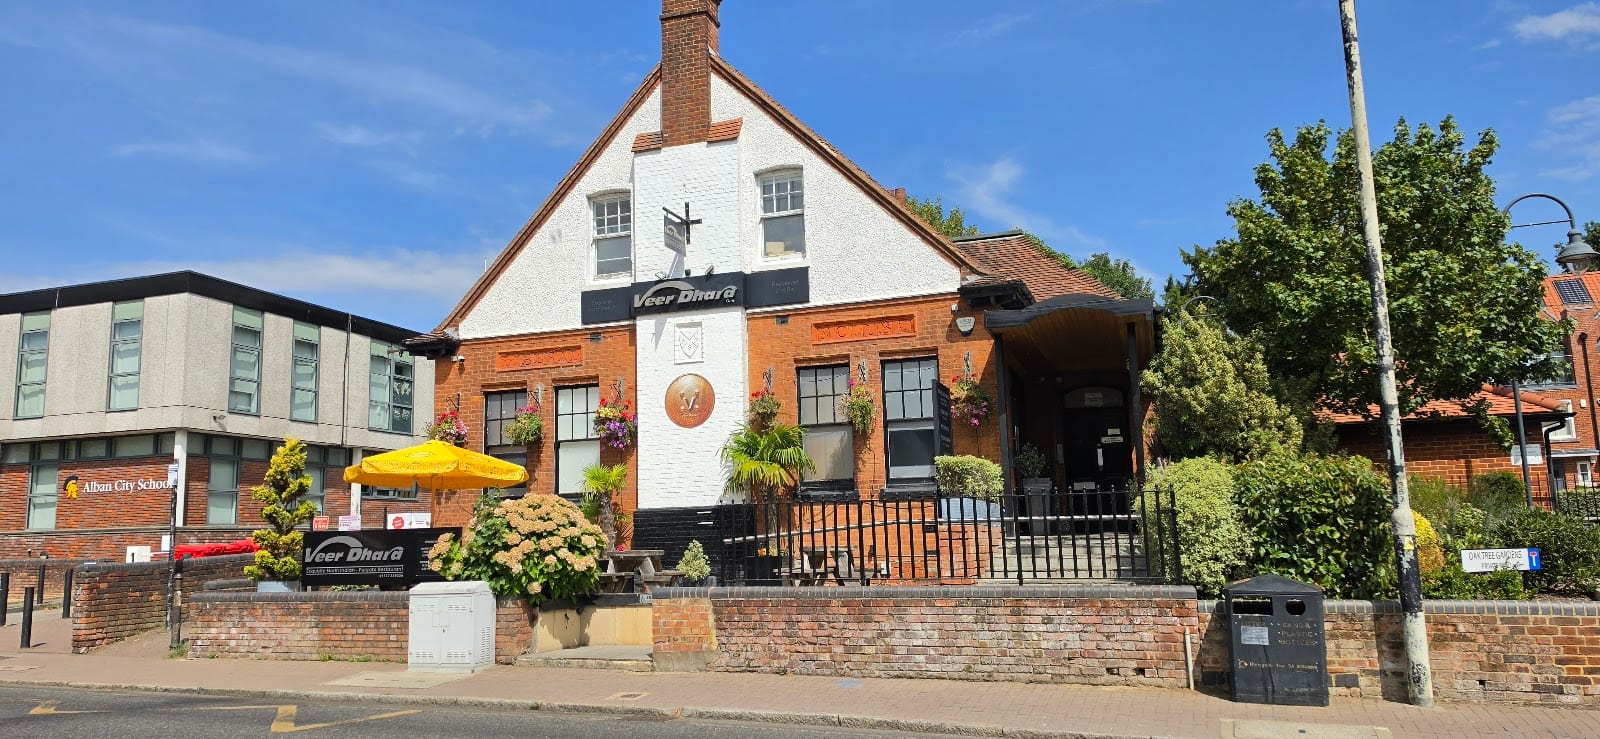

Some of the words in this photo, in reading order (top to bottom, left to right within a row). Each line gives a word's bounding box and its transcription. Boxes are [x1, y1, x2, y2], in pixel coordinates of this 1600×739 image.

[633, 293, 675, 308] Veer
[83, 481, 112, 493] Alban
[114, 479, 136, 493] City
[305, 547, 344, 563] Veer
[1469, 551, 1481, 560] OAK
[1481, 551, 1496, 560] TREE
